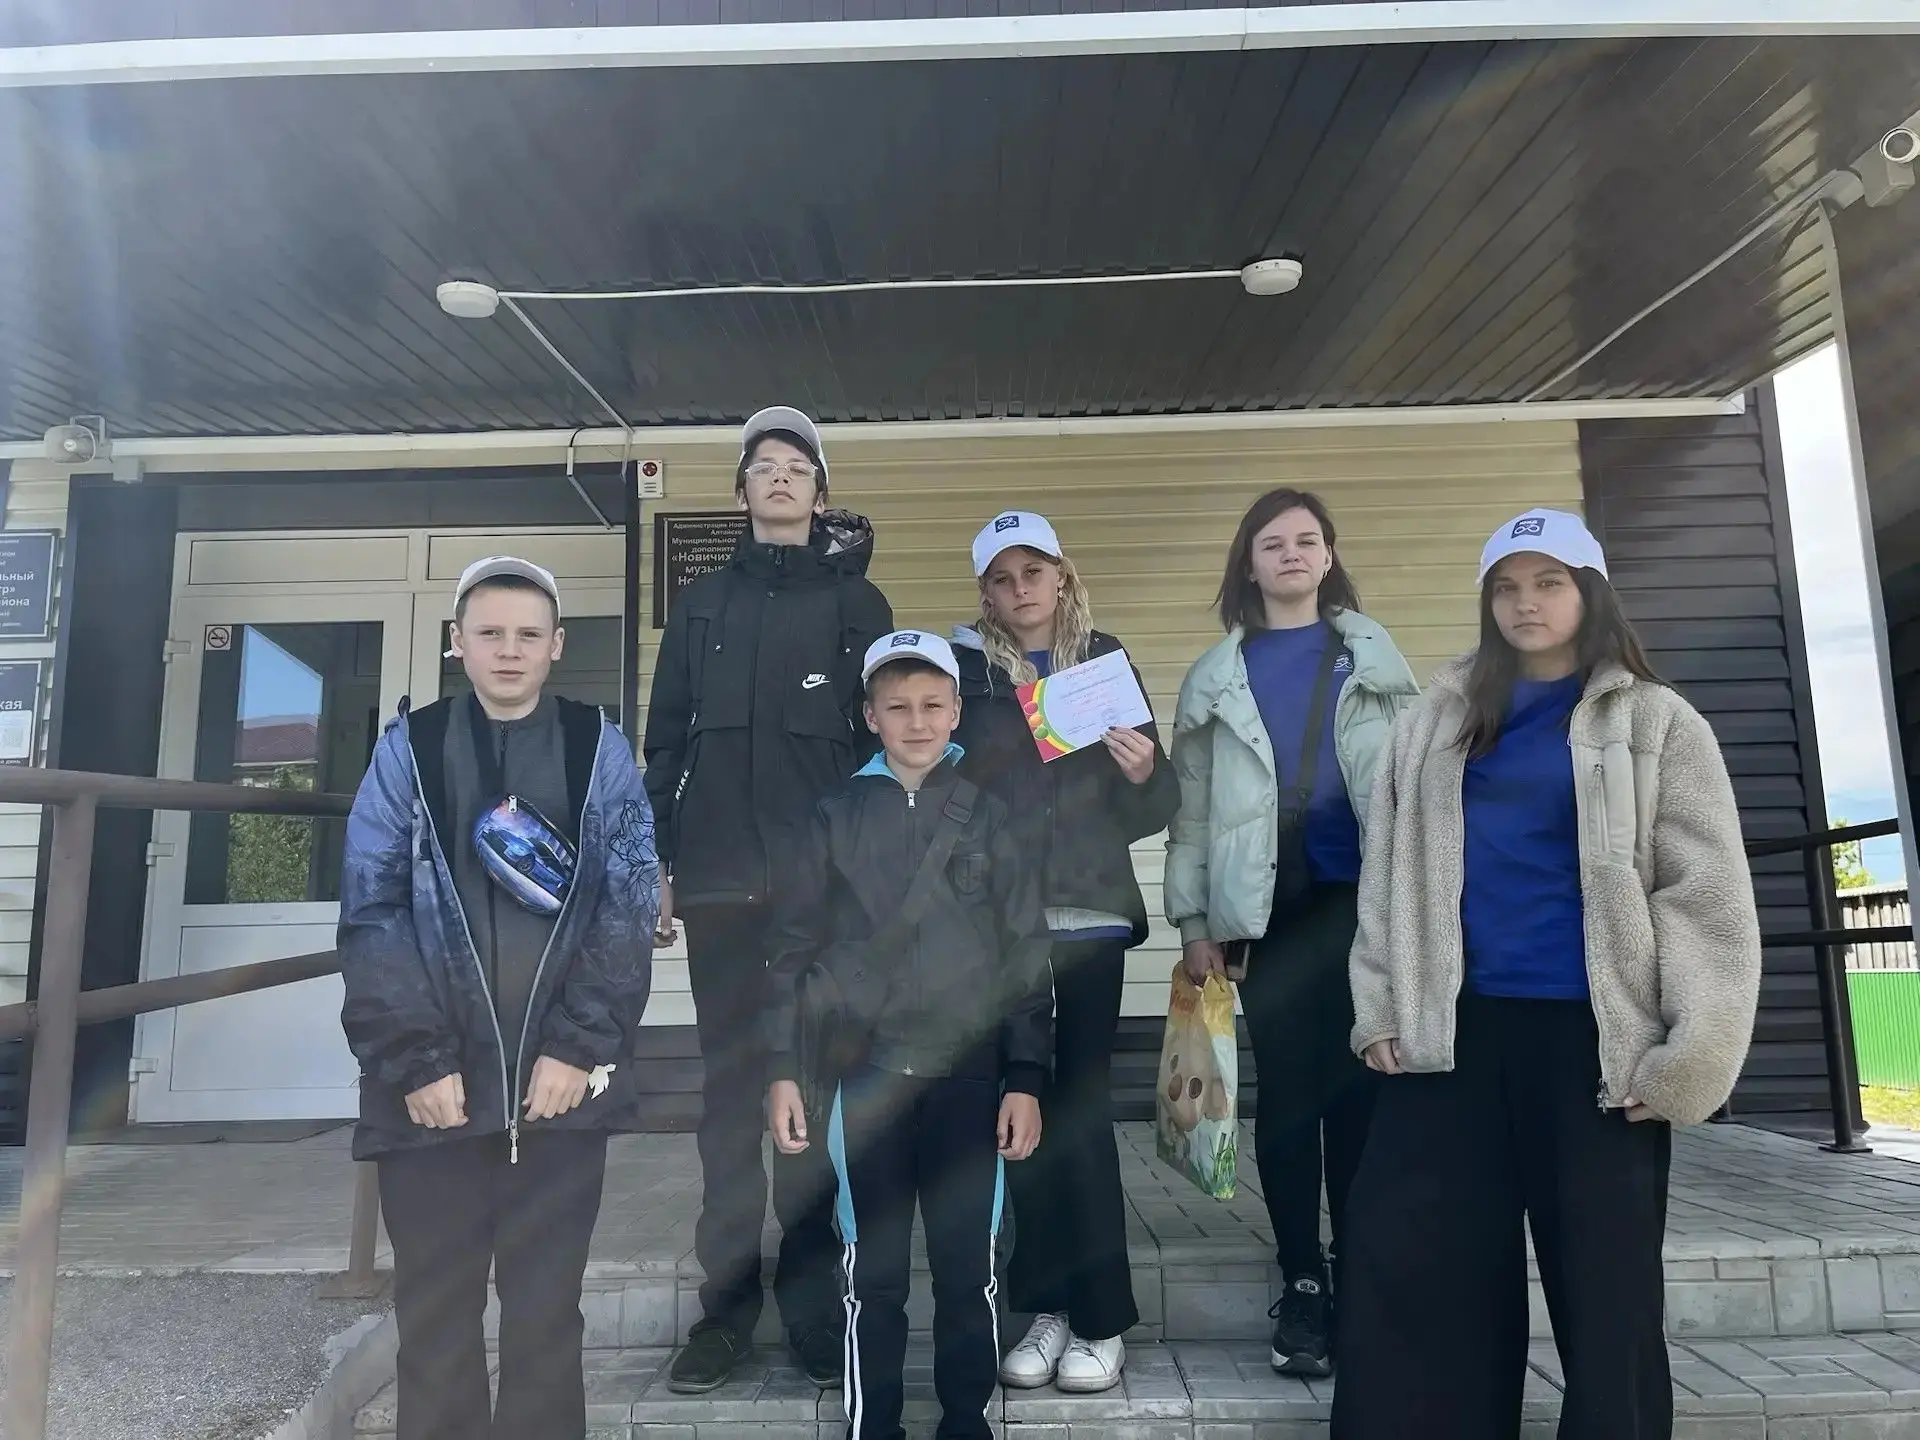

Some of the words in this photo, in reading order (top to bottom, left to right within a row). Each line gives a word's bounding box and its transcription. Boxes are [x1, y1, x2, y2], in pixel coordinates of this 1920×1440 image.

[671, 537, 737, 545] Муниципальное
[0, 571, 34, 581] ьный
[806, 673, 827, 682] NIKE
